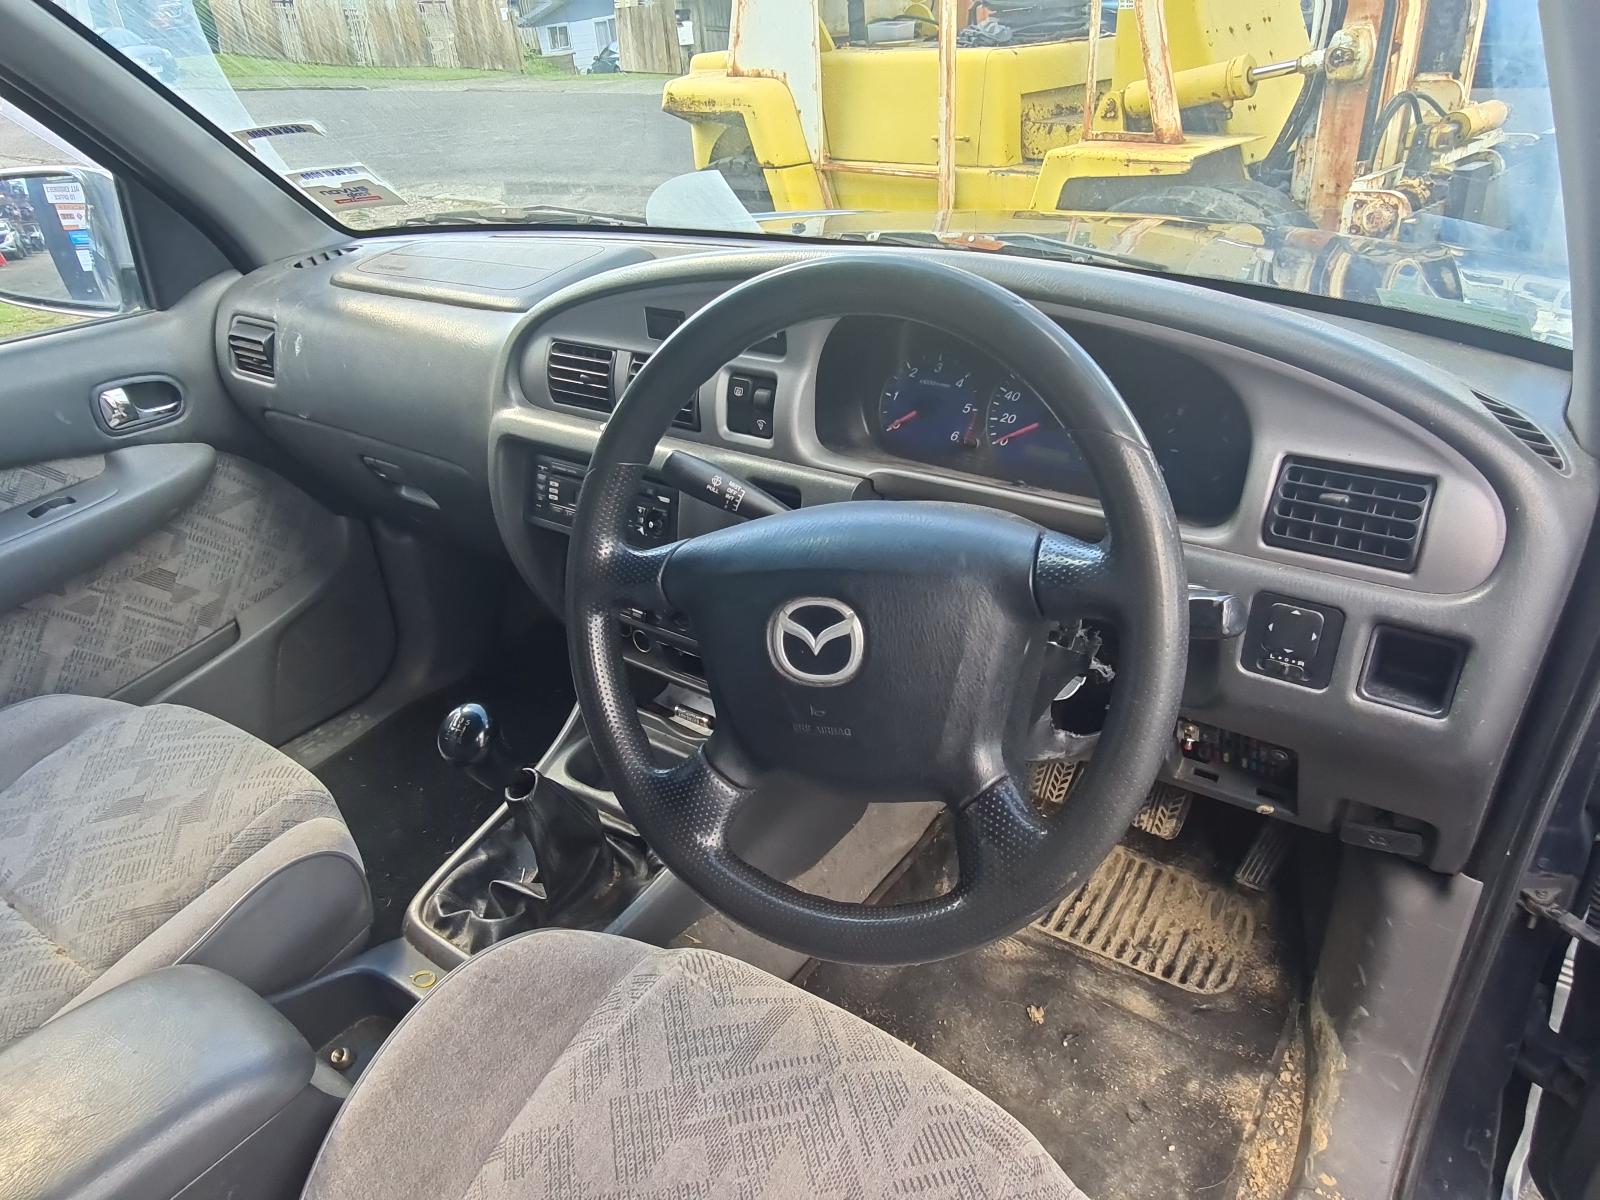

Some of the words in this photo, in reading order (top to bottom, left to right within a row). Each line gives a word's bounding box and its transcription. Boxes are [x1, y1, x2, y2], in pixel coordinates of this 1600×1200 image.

[908, 367, 918, 378] 2
[934, 362, 943, 373] 3
[955, 378, 965, 388] 4
[893, 391, 899, 401] 1
[1004, 391, 1021, 402] 40
[962, 403, 972, 414] 5
[1000, 413, 1017, 424] 20
[950, 431, 960, 442] 6
[707, 485, 719, 494] PULL
